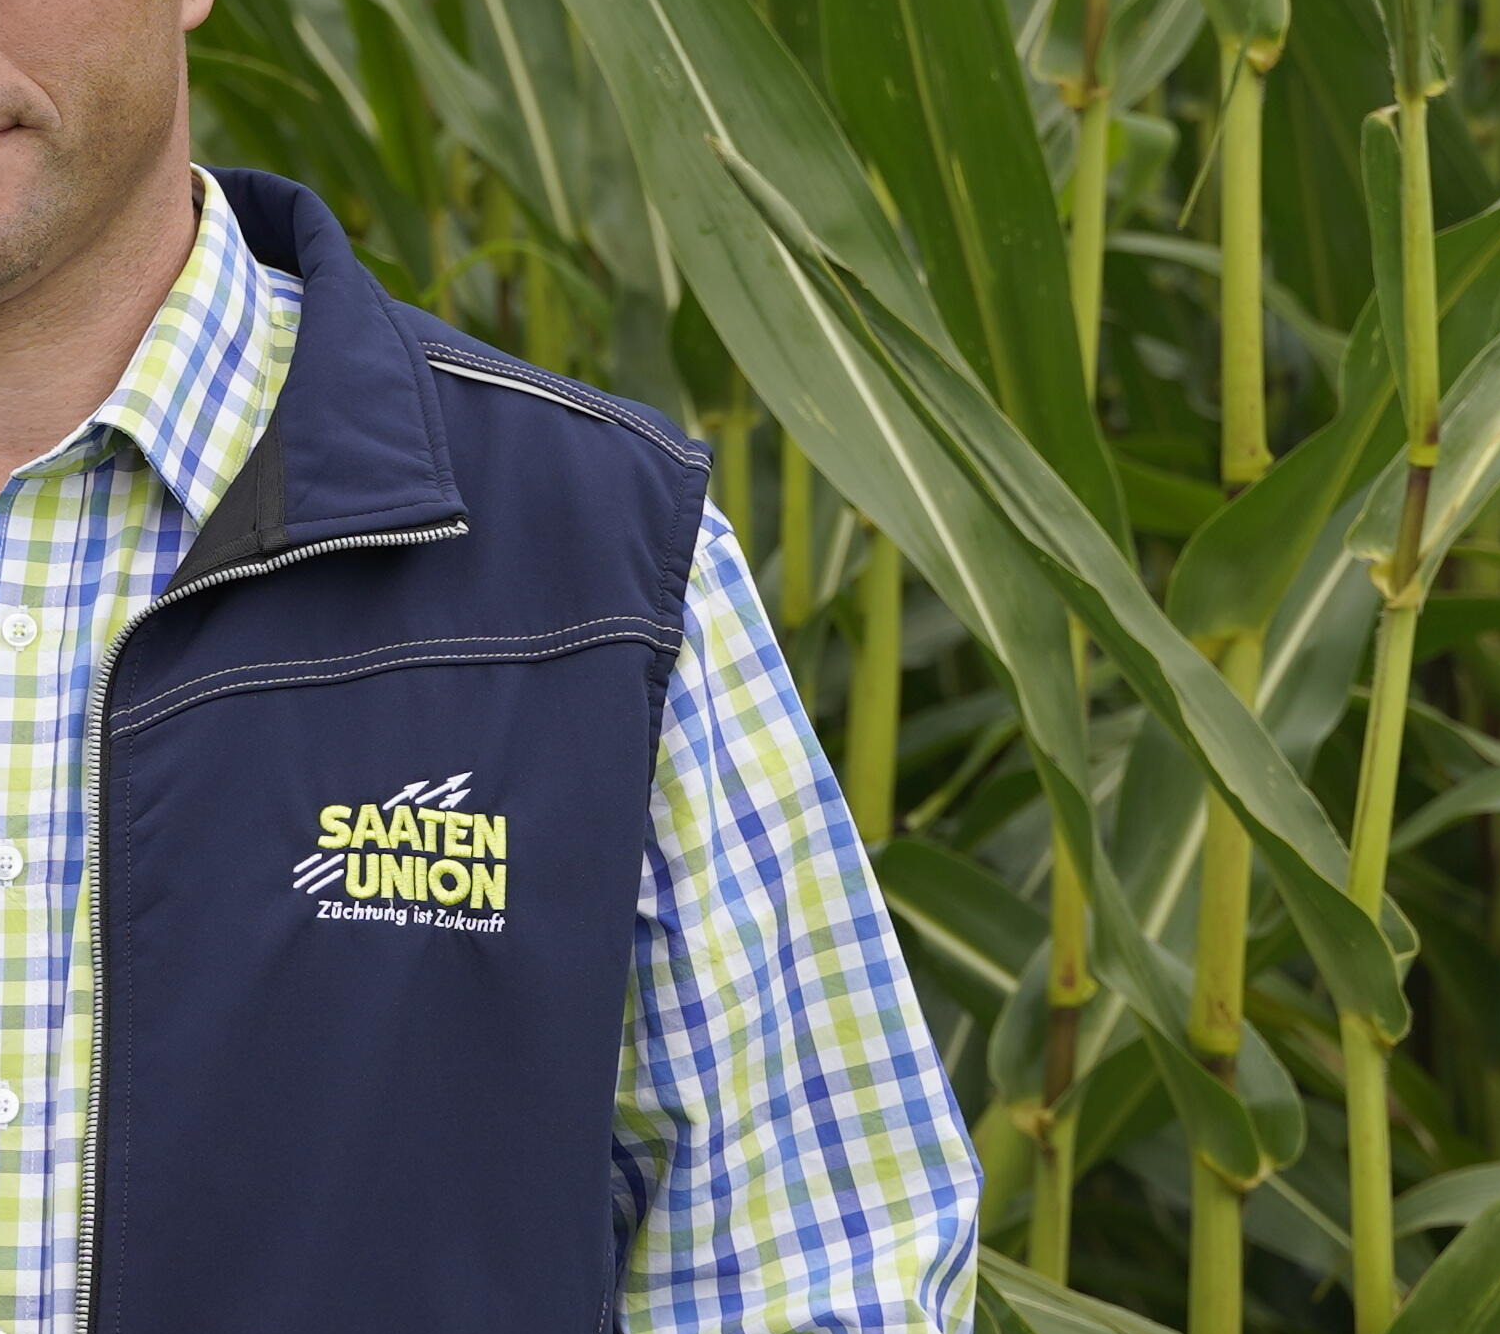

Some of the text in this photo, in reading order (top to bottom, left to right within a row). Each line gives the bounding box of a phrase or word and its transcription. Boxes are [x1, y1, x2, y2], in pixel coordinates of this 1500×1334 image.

[317, 803, 507, 860] SAATEN
[345, 853, 507, 910] UNION
[316, 900, 506, 933] Züchtung ist Zukunft
